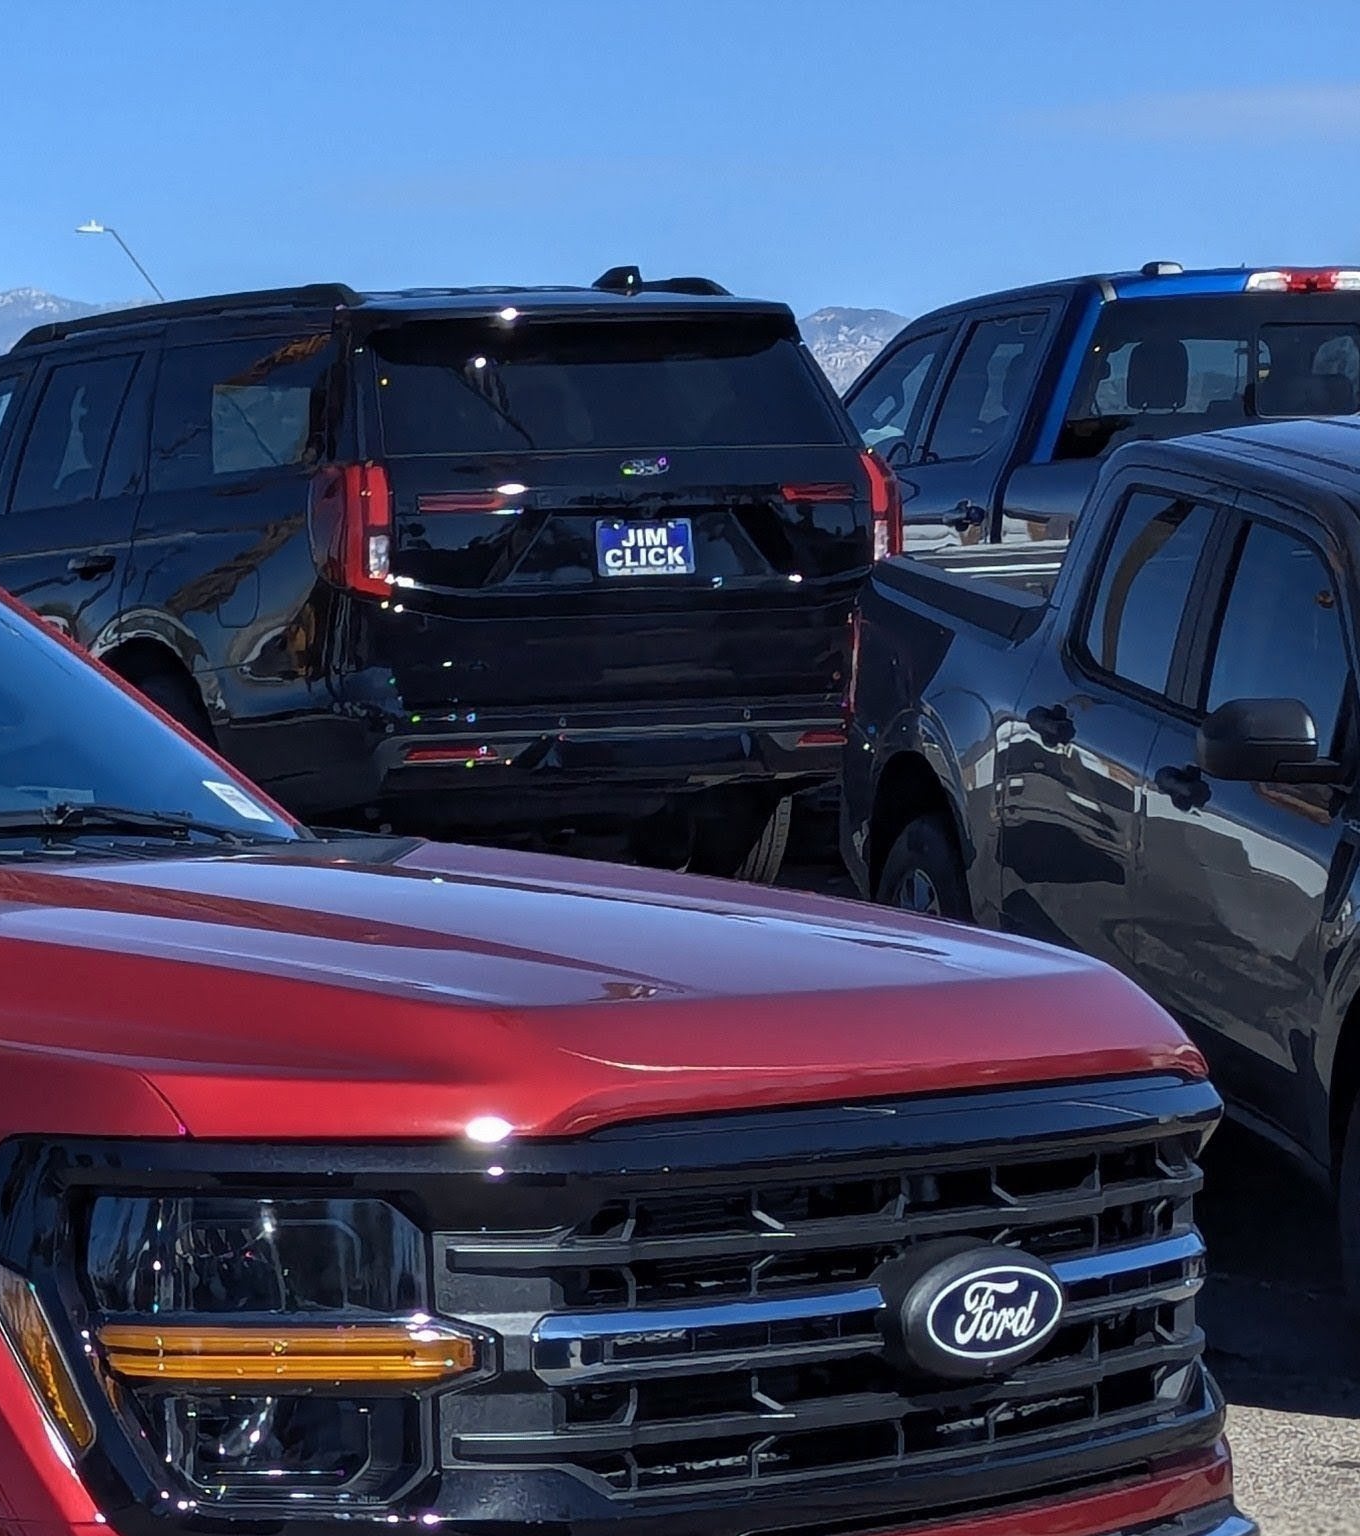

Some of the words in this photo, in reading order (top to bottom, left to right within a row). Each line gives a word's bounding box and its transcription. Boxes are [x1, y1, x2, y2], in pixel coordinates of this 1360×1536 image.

[621, 527, 667, 546] JIM
[605, 546, 685, 567] CLICK
[954, 1279, 1039, 1345] Ford
